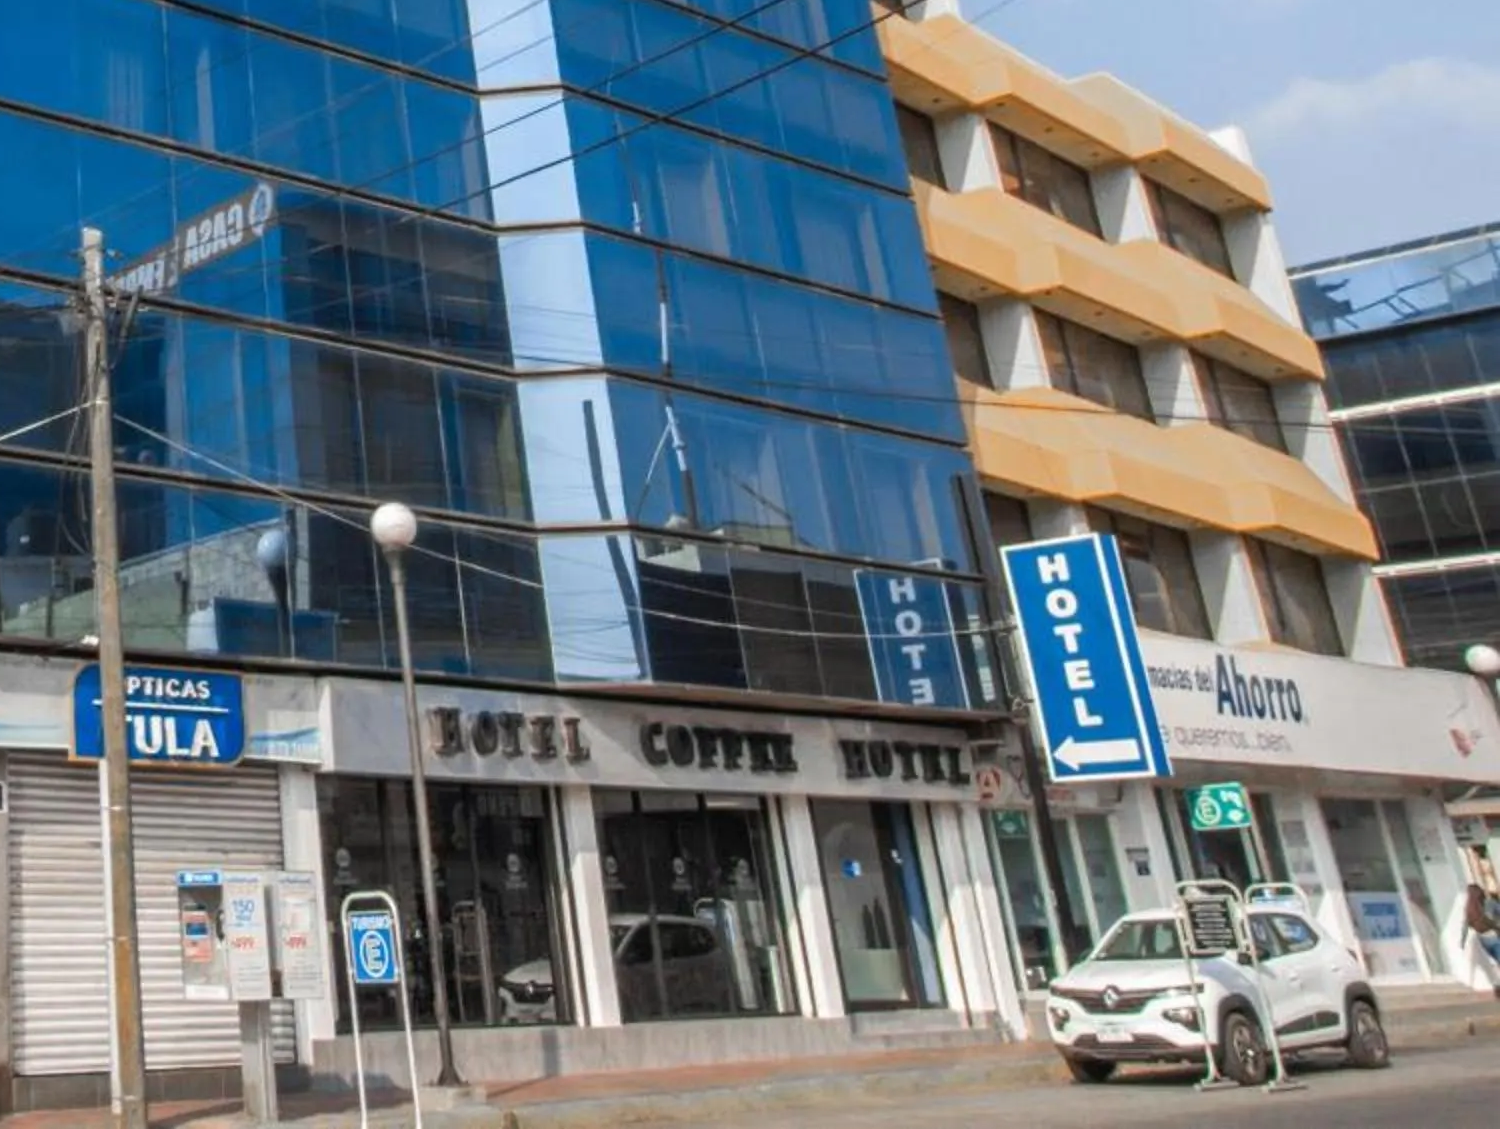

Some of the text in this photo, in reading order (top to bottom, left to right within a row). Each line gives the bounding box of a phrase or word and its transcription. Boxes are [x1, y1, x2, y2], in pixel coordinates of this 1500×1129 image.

[1037, 553, 1104, 728] HOTEL
[126, 676, 210, 699] PTICAS
[1147, 666, 1192, 691] macias
[1216, 654, 1302, 723] Ahorro
[126, 714, 219, 758] ULA
[430, 706, 971, 784] HOTEL COFFEE HOTEL
[365, 937, 382, 972] E
